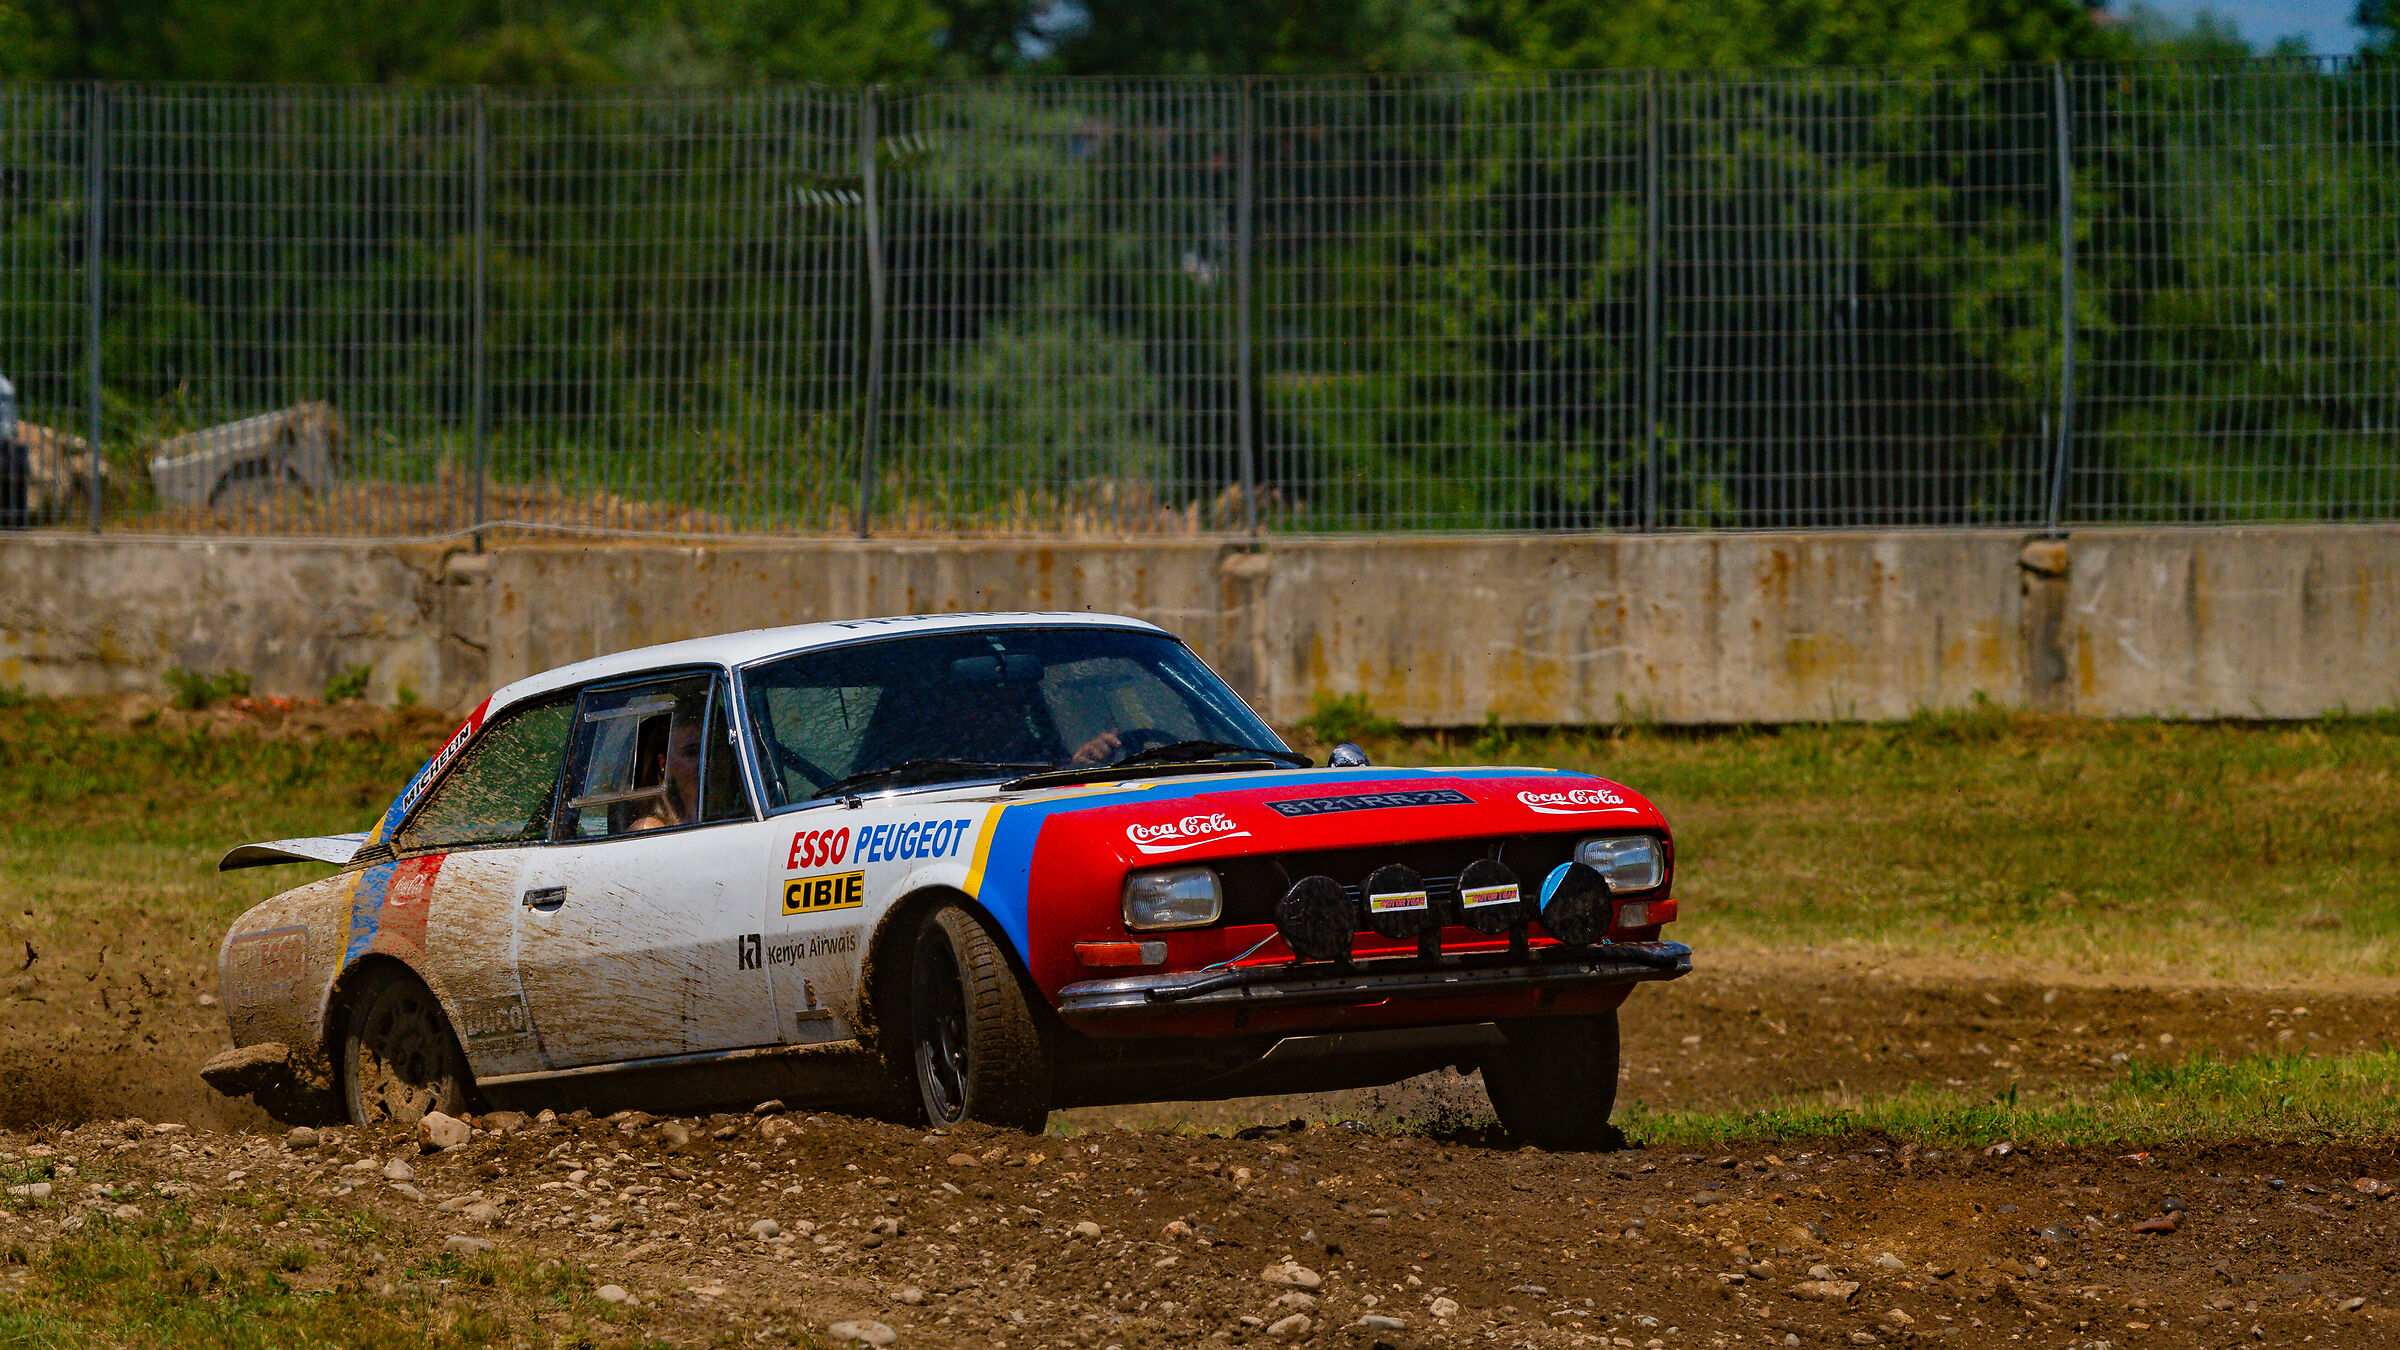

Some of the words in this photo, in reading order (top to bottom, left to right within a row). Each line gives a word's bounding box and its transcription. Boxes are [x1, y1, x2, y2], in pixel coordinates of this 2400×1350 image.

[403, 724, 470, 810] MICHELIN
[1517, 790, 1574, 806] Coca
[1568, 789, 1624, 804] Cola
[1126, 823, 1185, 844] Coca
[1179, 813, 1236, 835] Cola
[786, 827, 850, 869] ESSO
[853, 819, 971, 864] PEUGEOT
[1381, 898, 1406, 908] MOTOR
[768, 942, 805, 967] Kenya
